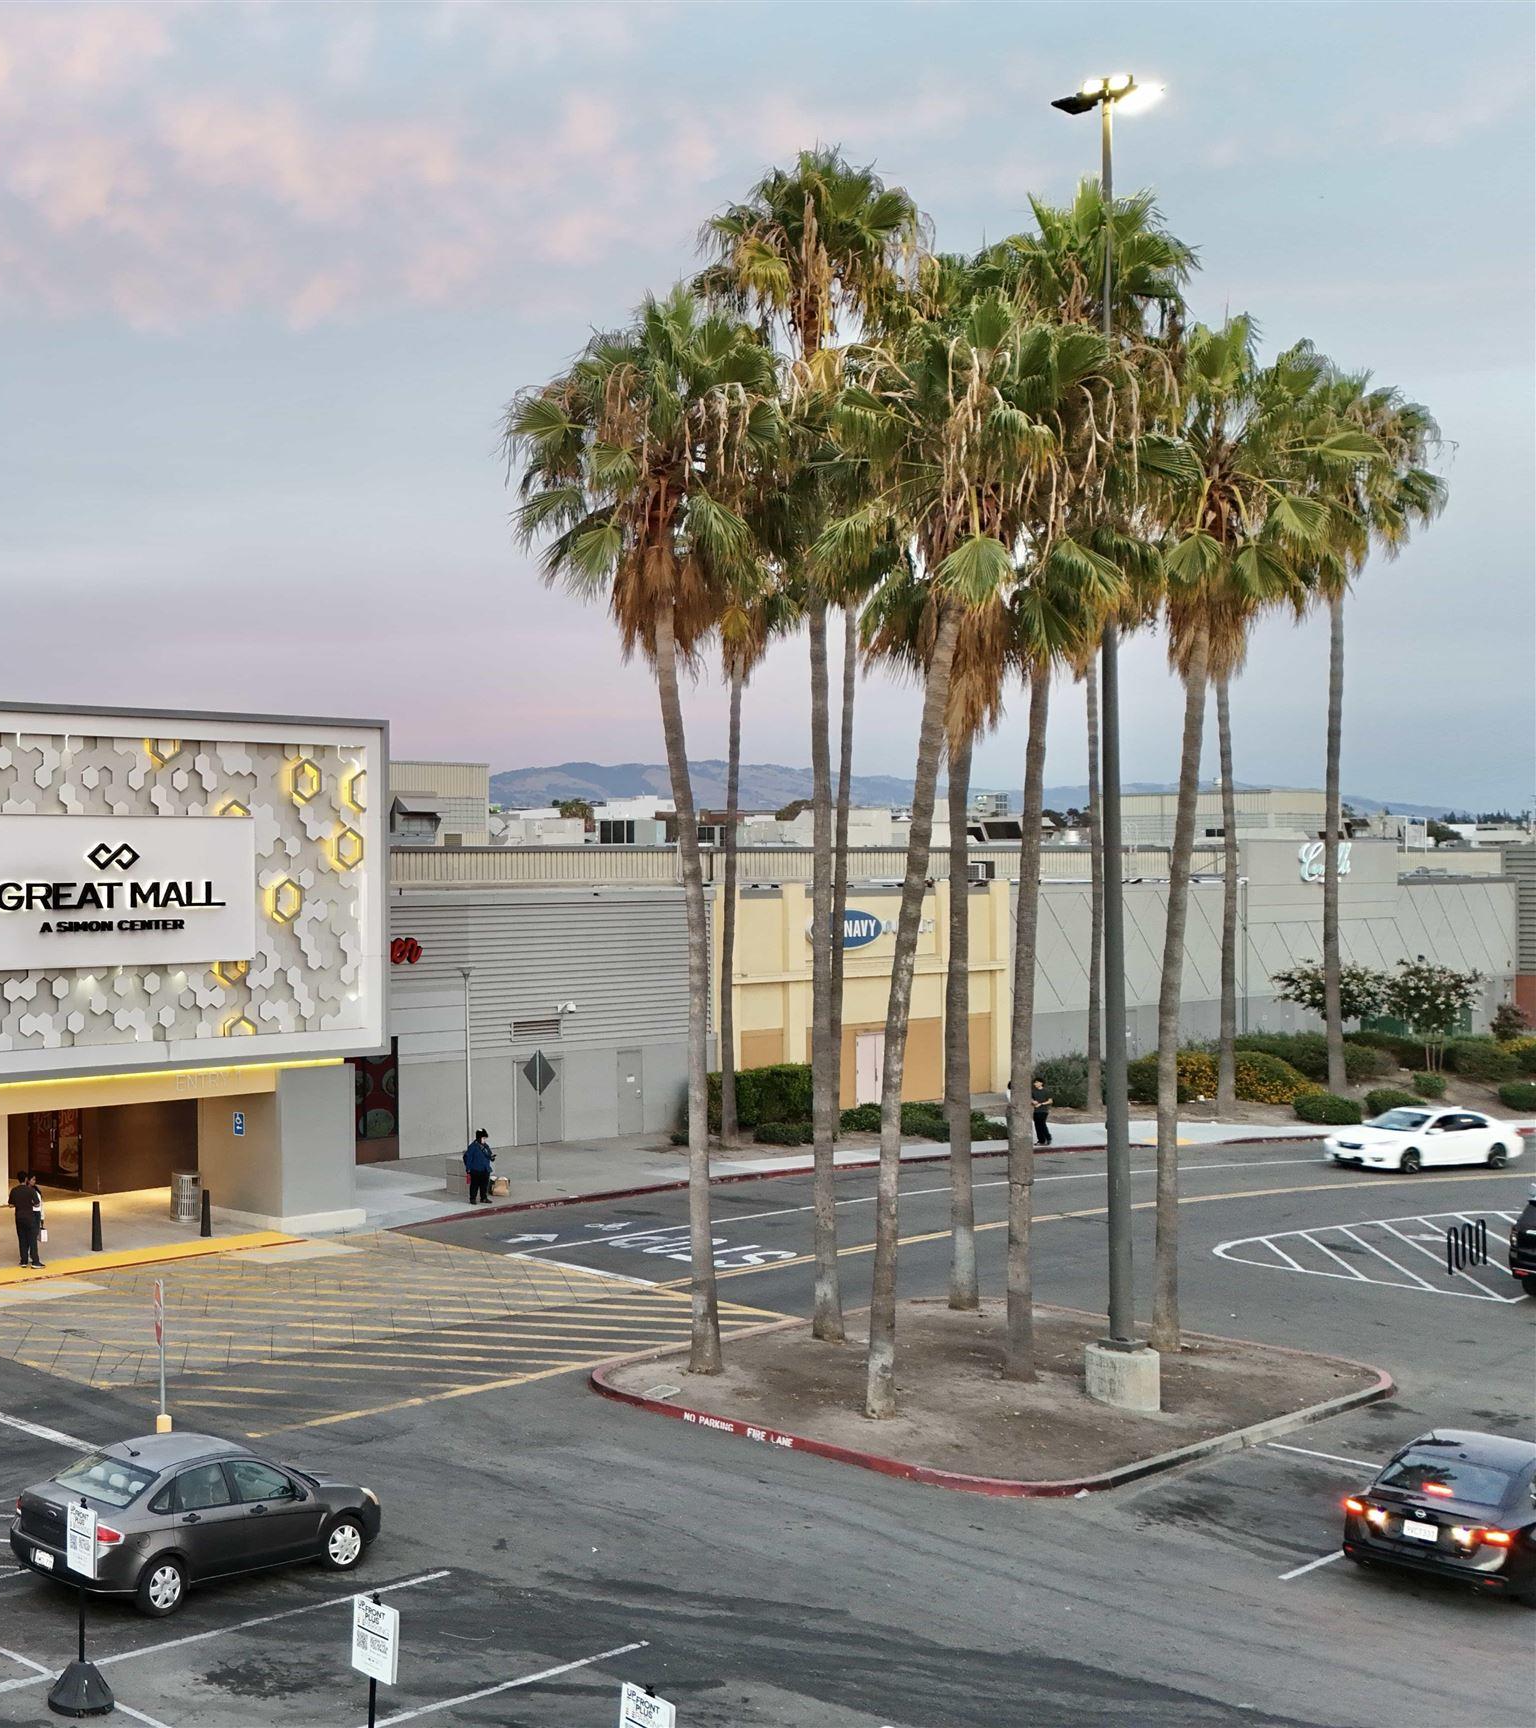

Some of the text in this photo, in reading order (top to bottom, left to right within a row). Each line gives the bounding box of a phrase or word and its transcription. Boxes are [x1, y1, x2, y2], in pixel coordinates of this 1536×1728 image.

[130, 881, 227, 908] MALL
[40, 919, 185, 933] A SIMON CENTER
[844, 919, 877, 938] NAVY
[684, 1411, 794, 1448] NO PARKING FIRE LANE
[635, 1703, 653, 1719] PLUS
